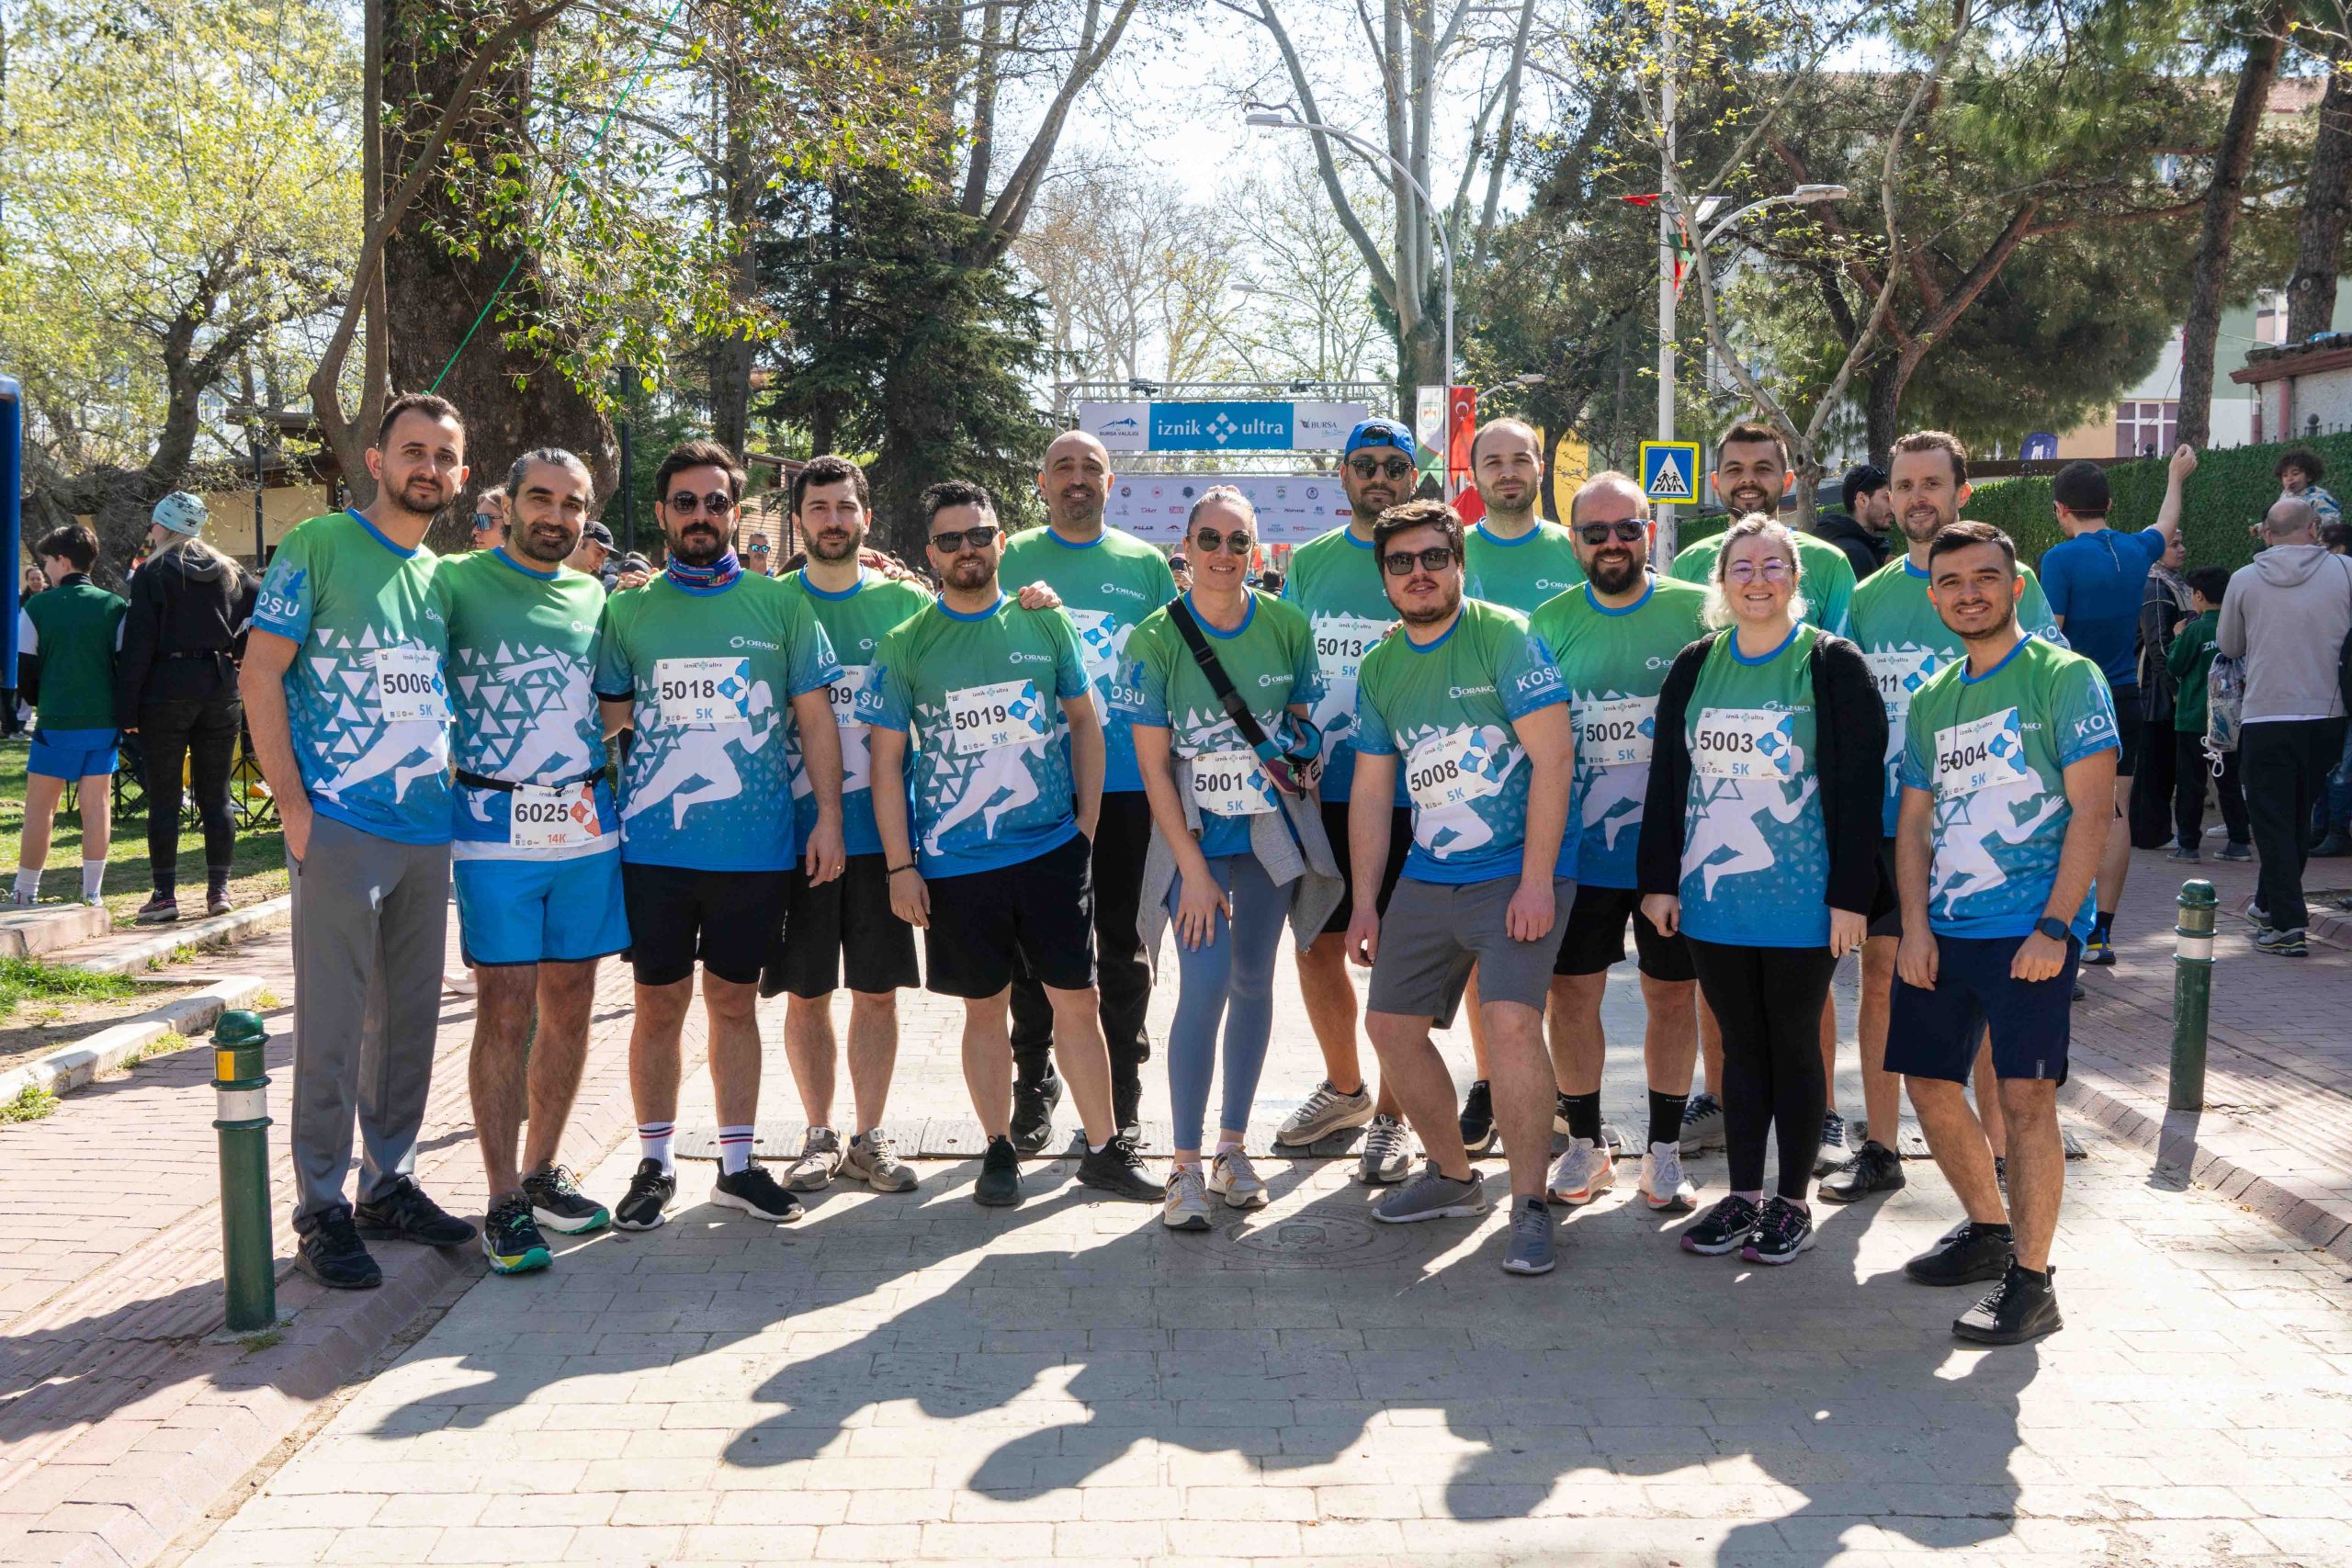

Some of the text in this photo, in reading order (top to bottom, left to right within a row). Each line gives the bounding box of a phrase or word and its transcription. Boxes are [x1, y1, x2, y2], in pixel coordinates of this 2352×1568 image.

[1158, 419, 1284, 435] iznik ultra
[1317, 638, 1363, 658] 5013
[1341, 665, 1358, 676] 5K
[1516, 666, 1562, 693] KOŞU
[383, 673, 432, 694] 5006
[662, 680, 716, 701] 5018
[1111, 685, 1146, 705] OŞU
[419, 705, 433, 716] 5K
[695, 707, 714, 719] 5K
[955, 705, 1007, 731] 5019
[991, 731, 1009, 744] 5K
[1586, 720, 1636, 742] 5002
[1700, 730, 1754, 753] 5003
[1618, 749, 1636, 761] 5K
[1940, 740, 1988, 774] 5004
[1410, 760, 1459, 792] 5008
[1732, 763, 1750, 775] 5K
[1194, 773, 1244, 793] 5001
[1971, 772, 1986, 787] 5K
[1447, 787, 1465, 802] 5K
[514, 803, 569, 823] 6025
[1227, 800, 1244, 812] 5K
[548, 833, 567, 844] 14K
